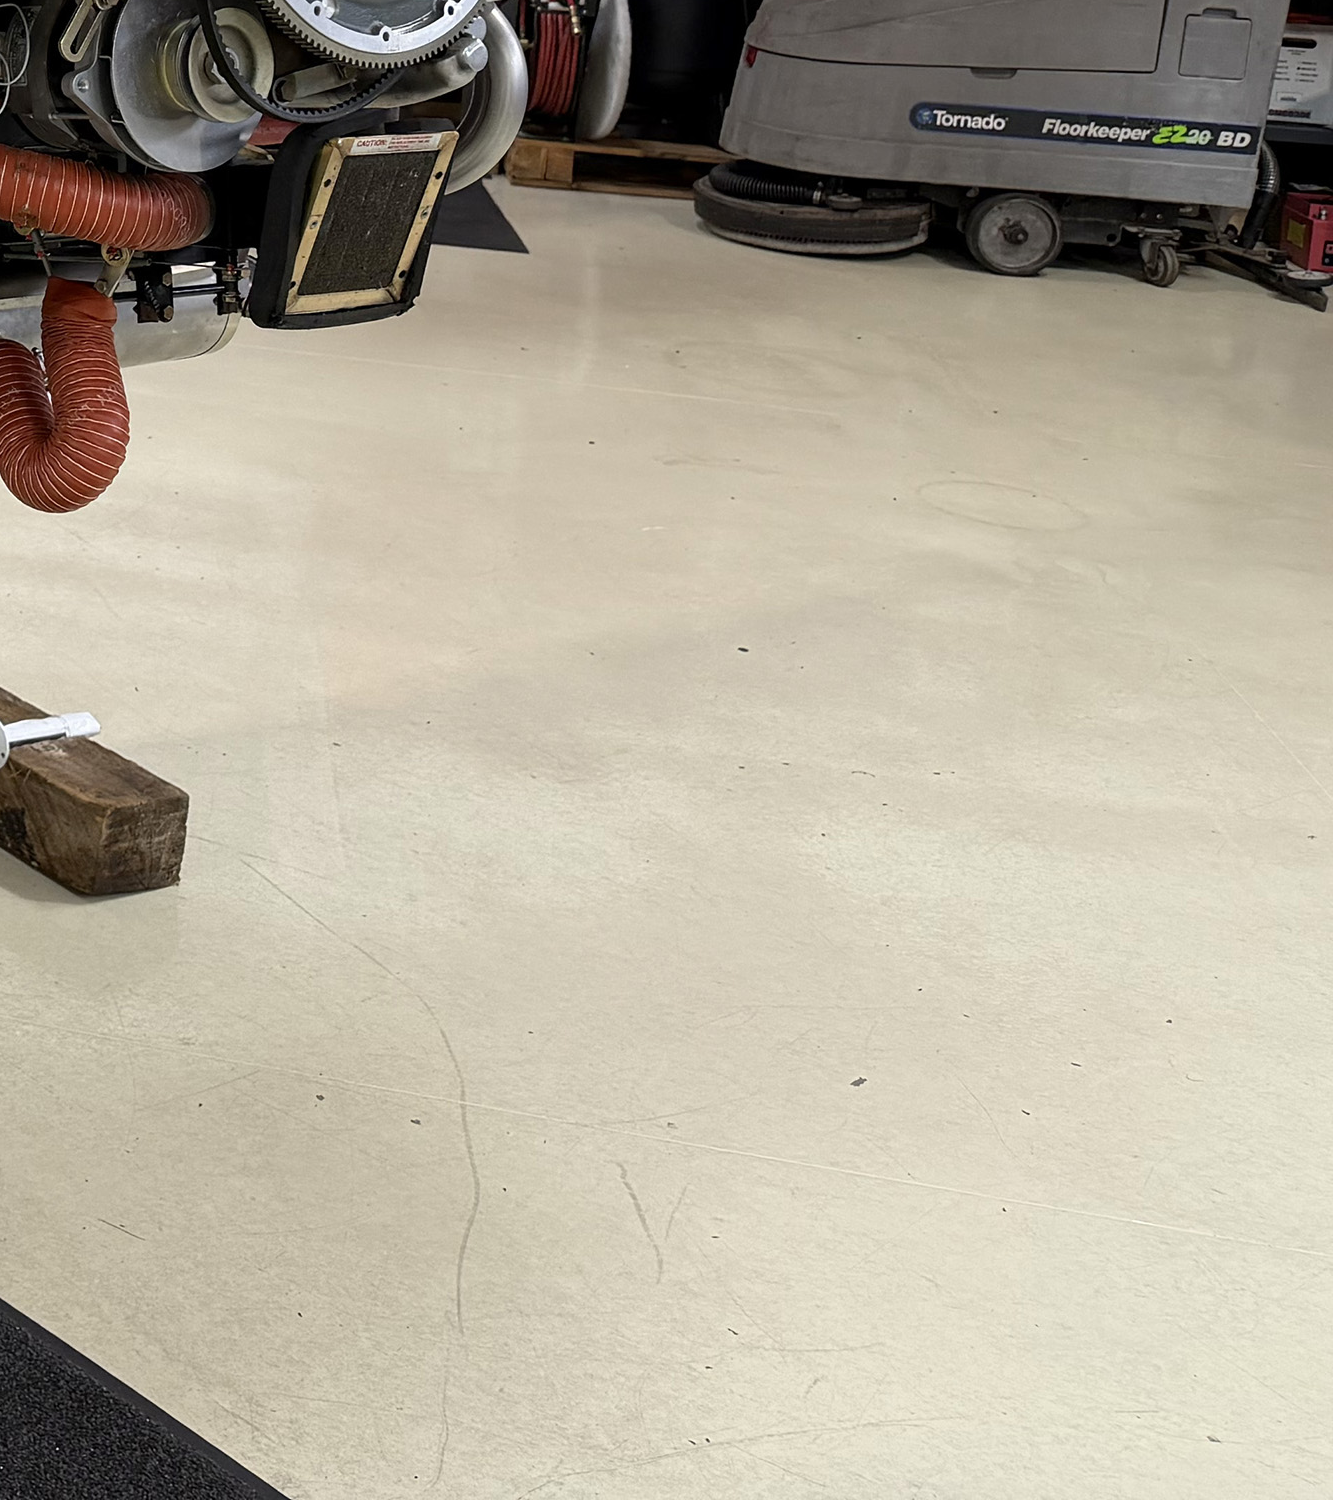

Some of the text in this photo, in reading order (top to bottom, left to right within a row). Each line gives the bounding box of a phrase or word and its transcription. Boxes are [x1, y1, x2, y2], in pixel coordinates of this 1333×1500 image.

[933, 109, 1006, 132] Tornado
[1041, 117, 1150, 142] Floorkeeper
[1216, 131, 1252, 149] BD
